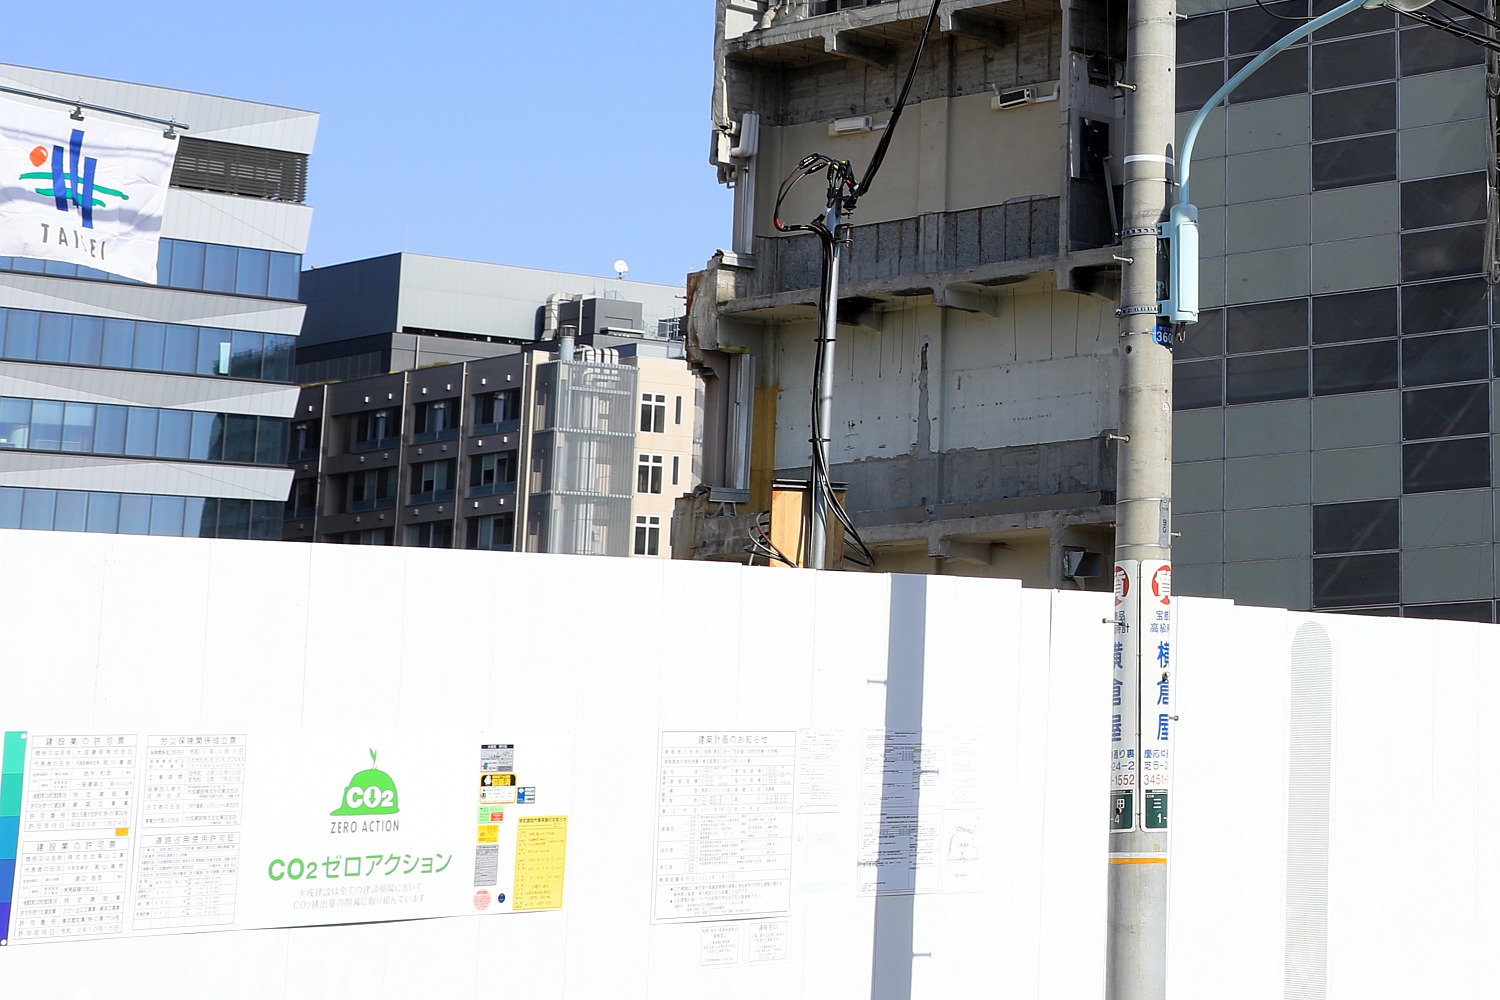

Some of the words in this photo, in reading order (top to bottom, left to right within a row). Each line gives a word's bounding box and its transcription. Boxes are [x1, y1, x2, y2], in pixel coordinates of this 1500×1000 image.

[46, 736, 125, 746] 建設業の許可票
[160, 736, 236, 746] 労災保険関係成立票
[698, 735, 768, 744] 建築計画のお知らせ
[1144, 749, 1168, 759] 慶応仲
[346, 785, 394, 808] CO2
[330, 821, 358, 834] ZERO
[361, 820, 400, 833] ACTION
[155, 834, 234, 845] 道路占用使用許可証
[37, 840, 116, 851] 建設業の許可票
[267, 852, 453, 882] CO2ゼロアクション
[298, 883, 423, 898] 大成建設は全ての建設現場において
[293, 894, 425, 910] CO2排出量の削減に取り組んでいます
